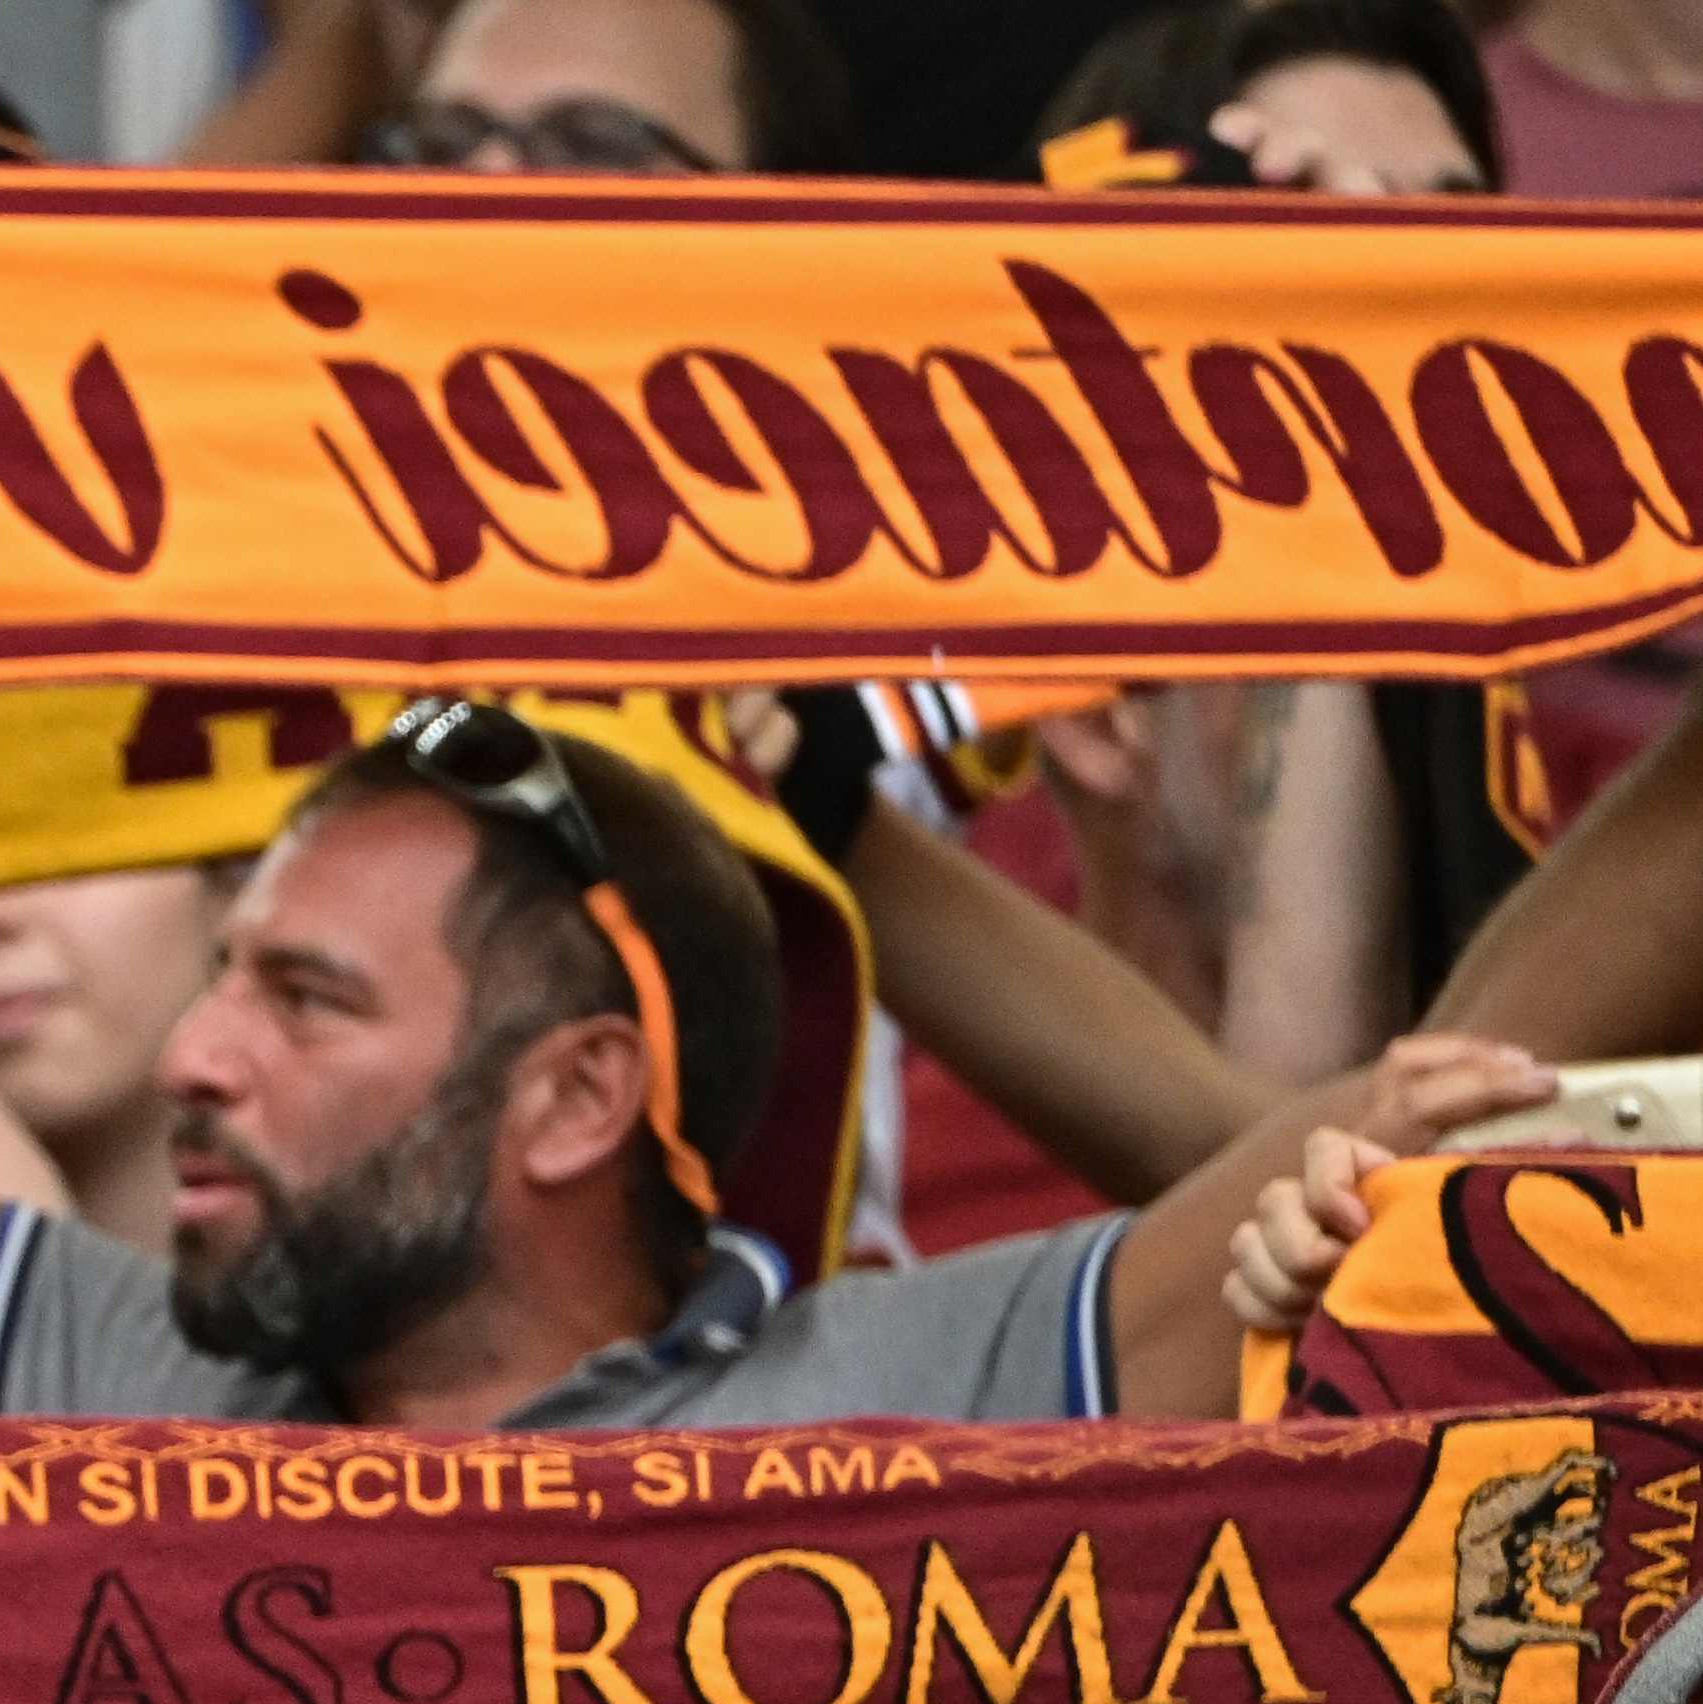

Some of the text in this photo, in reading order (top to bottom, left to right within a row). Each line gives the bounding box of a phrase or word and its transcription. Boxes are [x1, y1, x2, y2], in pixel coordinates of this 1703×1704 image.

[78, 1457, 159, 1526] SI
[190, 1450, 603, 1520] DISCUTE,
[632, 1446, 712, 1508] SI
[743, 1443, 942, 1500] AMA
[1615, 1463, 1702, 1652] OMA
